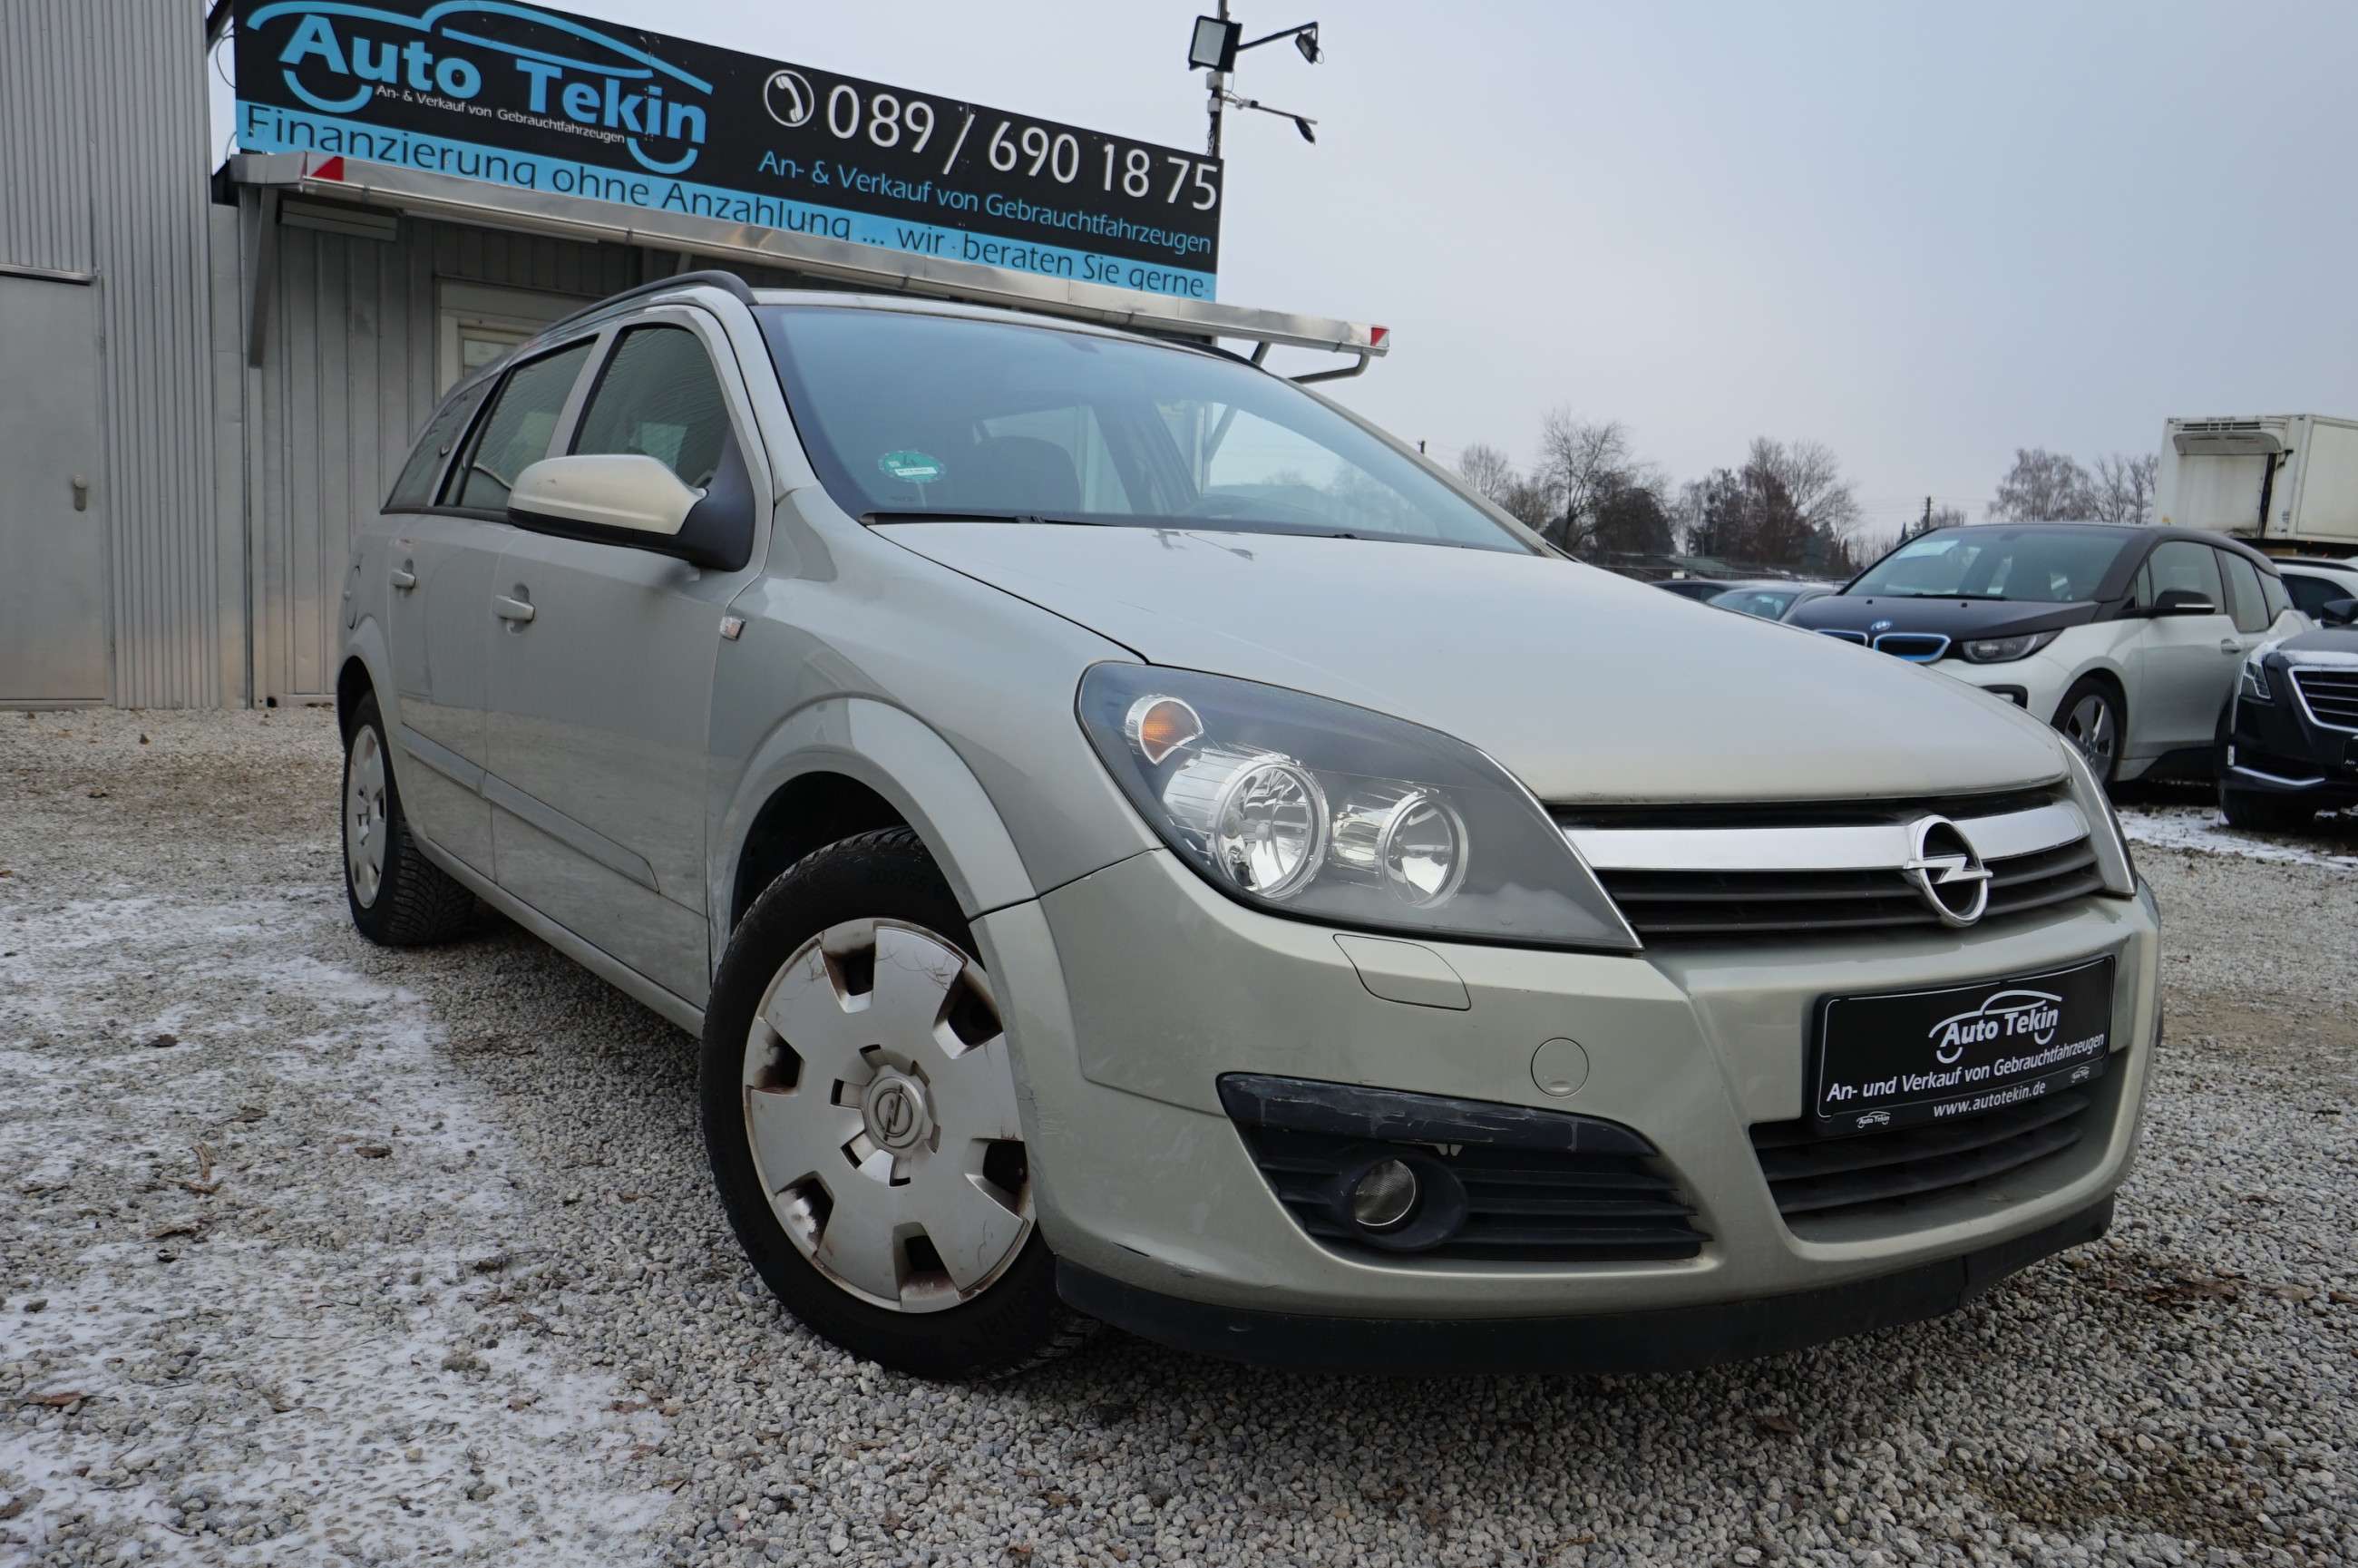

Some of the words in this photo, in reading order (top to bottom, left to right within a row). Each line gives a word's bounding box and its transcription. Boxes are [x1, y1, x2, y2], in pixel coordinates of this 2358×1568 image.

[279, 14, 482, 99] Auto
[515, 59, 706, 145] Tekin
[375, 84, 400, 100] An-
[403, 90, 413, 102] &
[416, 93, 467, 113] Verkauf
[468, 106, 492, 118] von
[497, 109, 626, 144] Gebrauchtfahrzeugen
[826, 83, 936, 153] 089
[988, 120, 1081, 183] 690
[1103, 143, 1151, 198] 18
[1165, 156, 1218, 210] 75
[248, 104, 537, 190] Finanzierung
[552, 168, 649, 207] ohne
[660, 181, 851, 241] Anzahlung
[898, 226, 945, 255] wir
[962, 233, 1073, 277] beraten
[1084, 253, 1119, 284] Sie
[1128, 268, 1205, 297] gerne
[759, 151, 804, 179] An-
[812, 161, 830, 185] &
[838, 164, 932, 203] Verkauf
[937, 188, 979, 212] von
[986, 193, 1211, 255] Gebrauchtfahrzeugen
[1827, 1083, 1857, 1102] An-
[1863, 1076, 1897, 1097] und
[1902, 1066, 1963, 1092] Verkauf
[1964, 1066, 1990, 1082] von
[1994, 1033, 2105, 1076] Gebrauchtfahrzeugen
[1940, 1019, 1998, 1047] Auto
[2004, 1006, 2059, 1036] Tekin
[1934, 1081, 2046, 1117] www.autotekin.de
